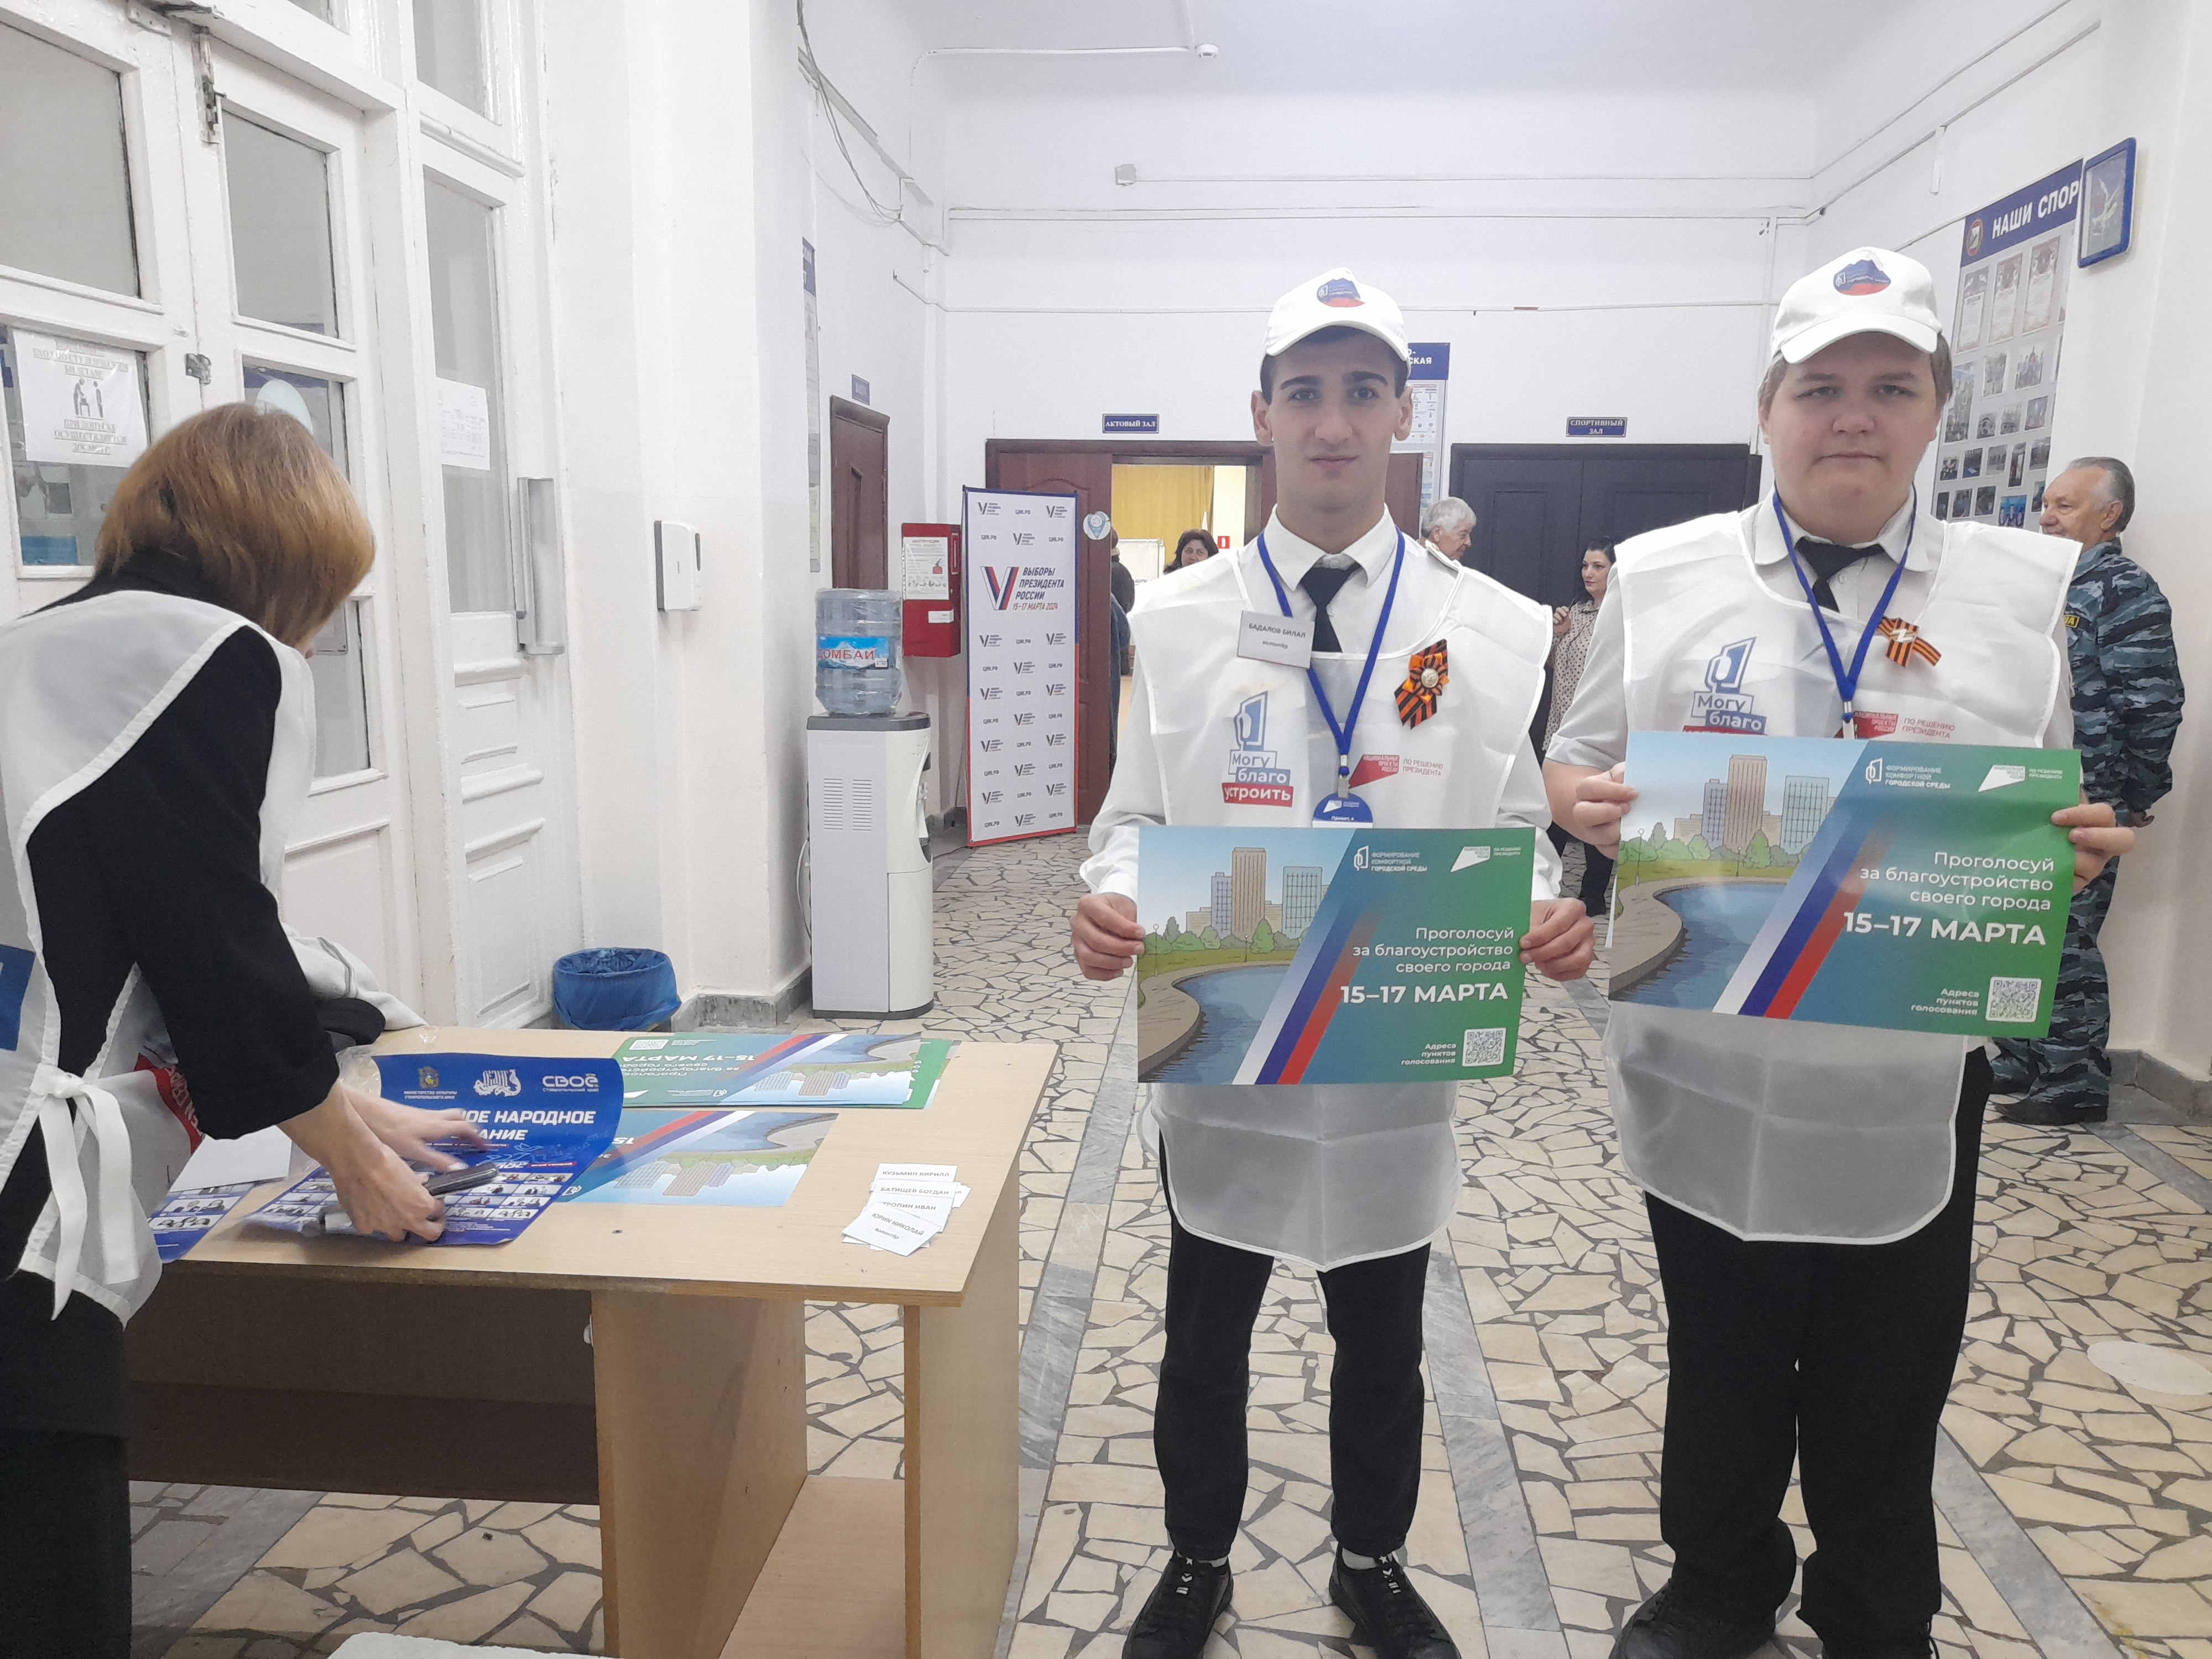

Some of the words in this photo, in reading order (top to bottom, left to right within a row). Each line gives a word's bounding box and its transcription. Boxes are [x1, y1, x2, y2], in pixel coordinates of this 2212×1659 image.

[1992, 202, 2032, 239] НАШИ
[2038, 180, 2079, 218] СПОР
[1022, 567, 1056, 576] ВЫБОРЫ
[1019, 580, 1065, 589] ПРЕЗИДЕНТА
[1015, 591, 1045, 600] РОССИИ
[1249, 623, 1281, 634] БАДАЛОВ
[1283, 629, 1306, 638] БИЛАЛ
[1698, 695, 1746, 712] Могу
[1709, 711, 1762, 731] благо
[1917, 720, 1955, 731] РЕШЕНИЮ
[1902, 726, 1950, 739] ПРЕЗИДЕНТА
[1232, 753, 1270, 768] Могу
[1413, 760, 1443, 769] РЕШЕНИЮ
[1238, 768, 1287, 784] благо
[1402, 766, 1441, 776] ПРЕЗИДЕНТА
[1224, 786, 1292, 801] устроить
[1934, 851, 2054, 873] Проголосуй
[1860, 868, 1880, 879] за
[1886, 867, 2053, 891] благоустройство
[1910, 891, 1975, 906] своего
[1981, 896, 2051, 911] города
[1416, 927, 1514, 942] Проголосуй
[1931, 919, 2046, 946] МАРТА
[1353, 946, 1370, 956] за
[1375, 943, 1513, 958] благоустройство
[1396, 963, 1451, 973] своего
[1455, 961, 1510, 973] города
[1414, 983, 1508, 1003] МАРТА
[1940, 988, 1980, 998] Адреса
[1911, 1005, 1978, 1015] голосования
[1936, 998, 1979, 1007] пунктов
[494, 1110, 596, 1125] НАРОДНОЕ
[476, 1129, 529, 1140] АНИЕ
[872, 1213, 891, 1224] ЮРИН
[891, 1220, 925, 1236] НИКОЛАЙ
[874, 1227, 900, 1239] волонтёр
